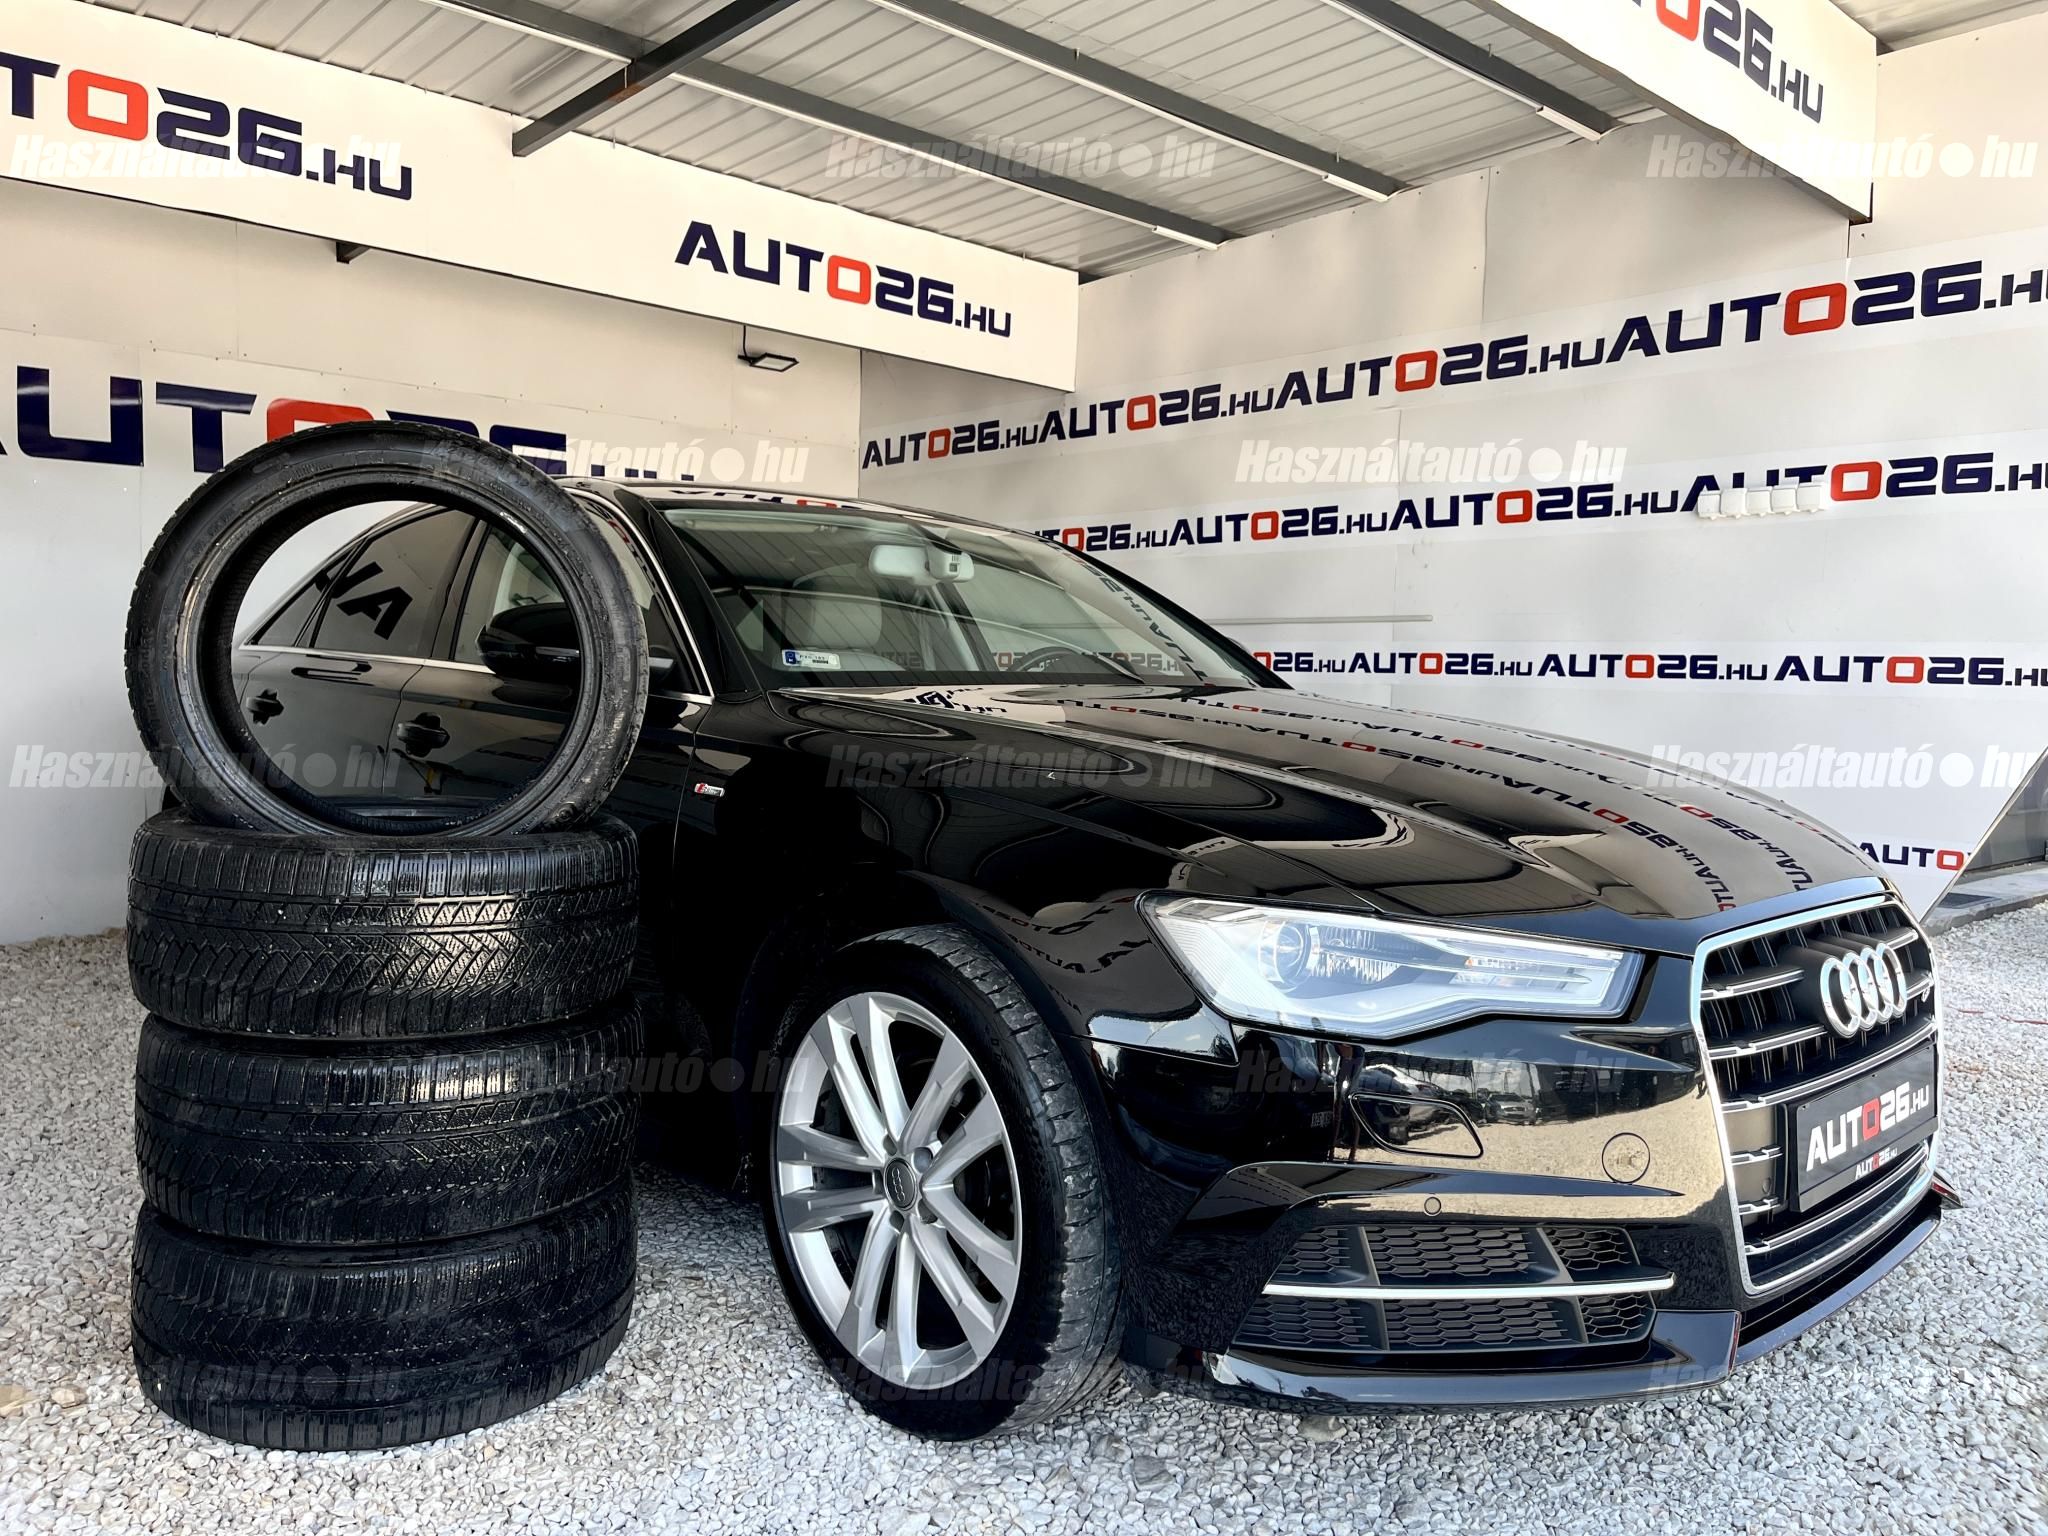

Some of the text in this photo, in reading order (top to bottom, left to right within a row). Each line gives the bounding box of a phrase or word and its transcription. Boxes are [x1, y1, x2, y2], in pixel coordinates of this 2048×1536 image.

[675, 221, 1011, 337] AUTO26.HU
[862, 260, 2048, 469] AUTO26.HU AUTO26.HU AUTO26.HU AUTO26.H
[1168, 505, 1387, 546] AUTO26.HU
[1389, 483, 1679, 530] AUTO26.HU
[1350, 652, 1532, 676] AUTO26.HU
[1537, 653, 1767, 680] AUTO26.HU
[1860, 842, 1971, 871] AUTO
[1806, 1081, 1930, 1172] AUTO26.HU
